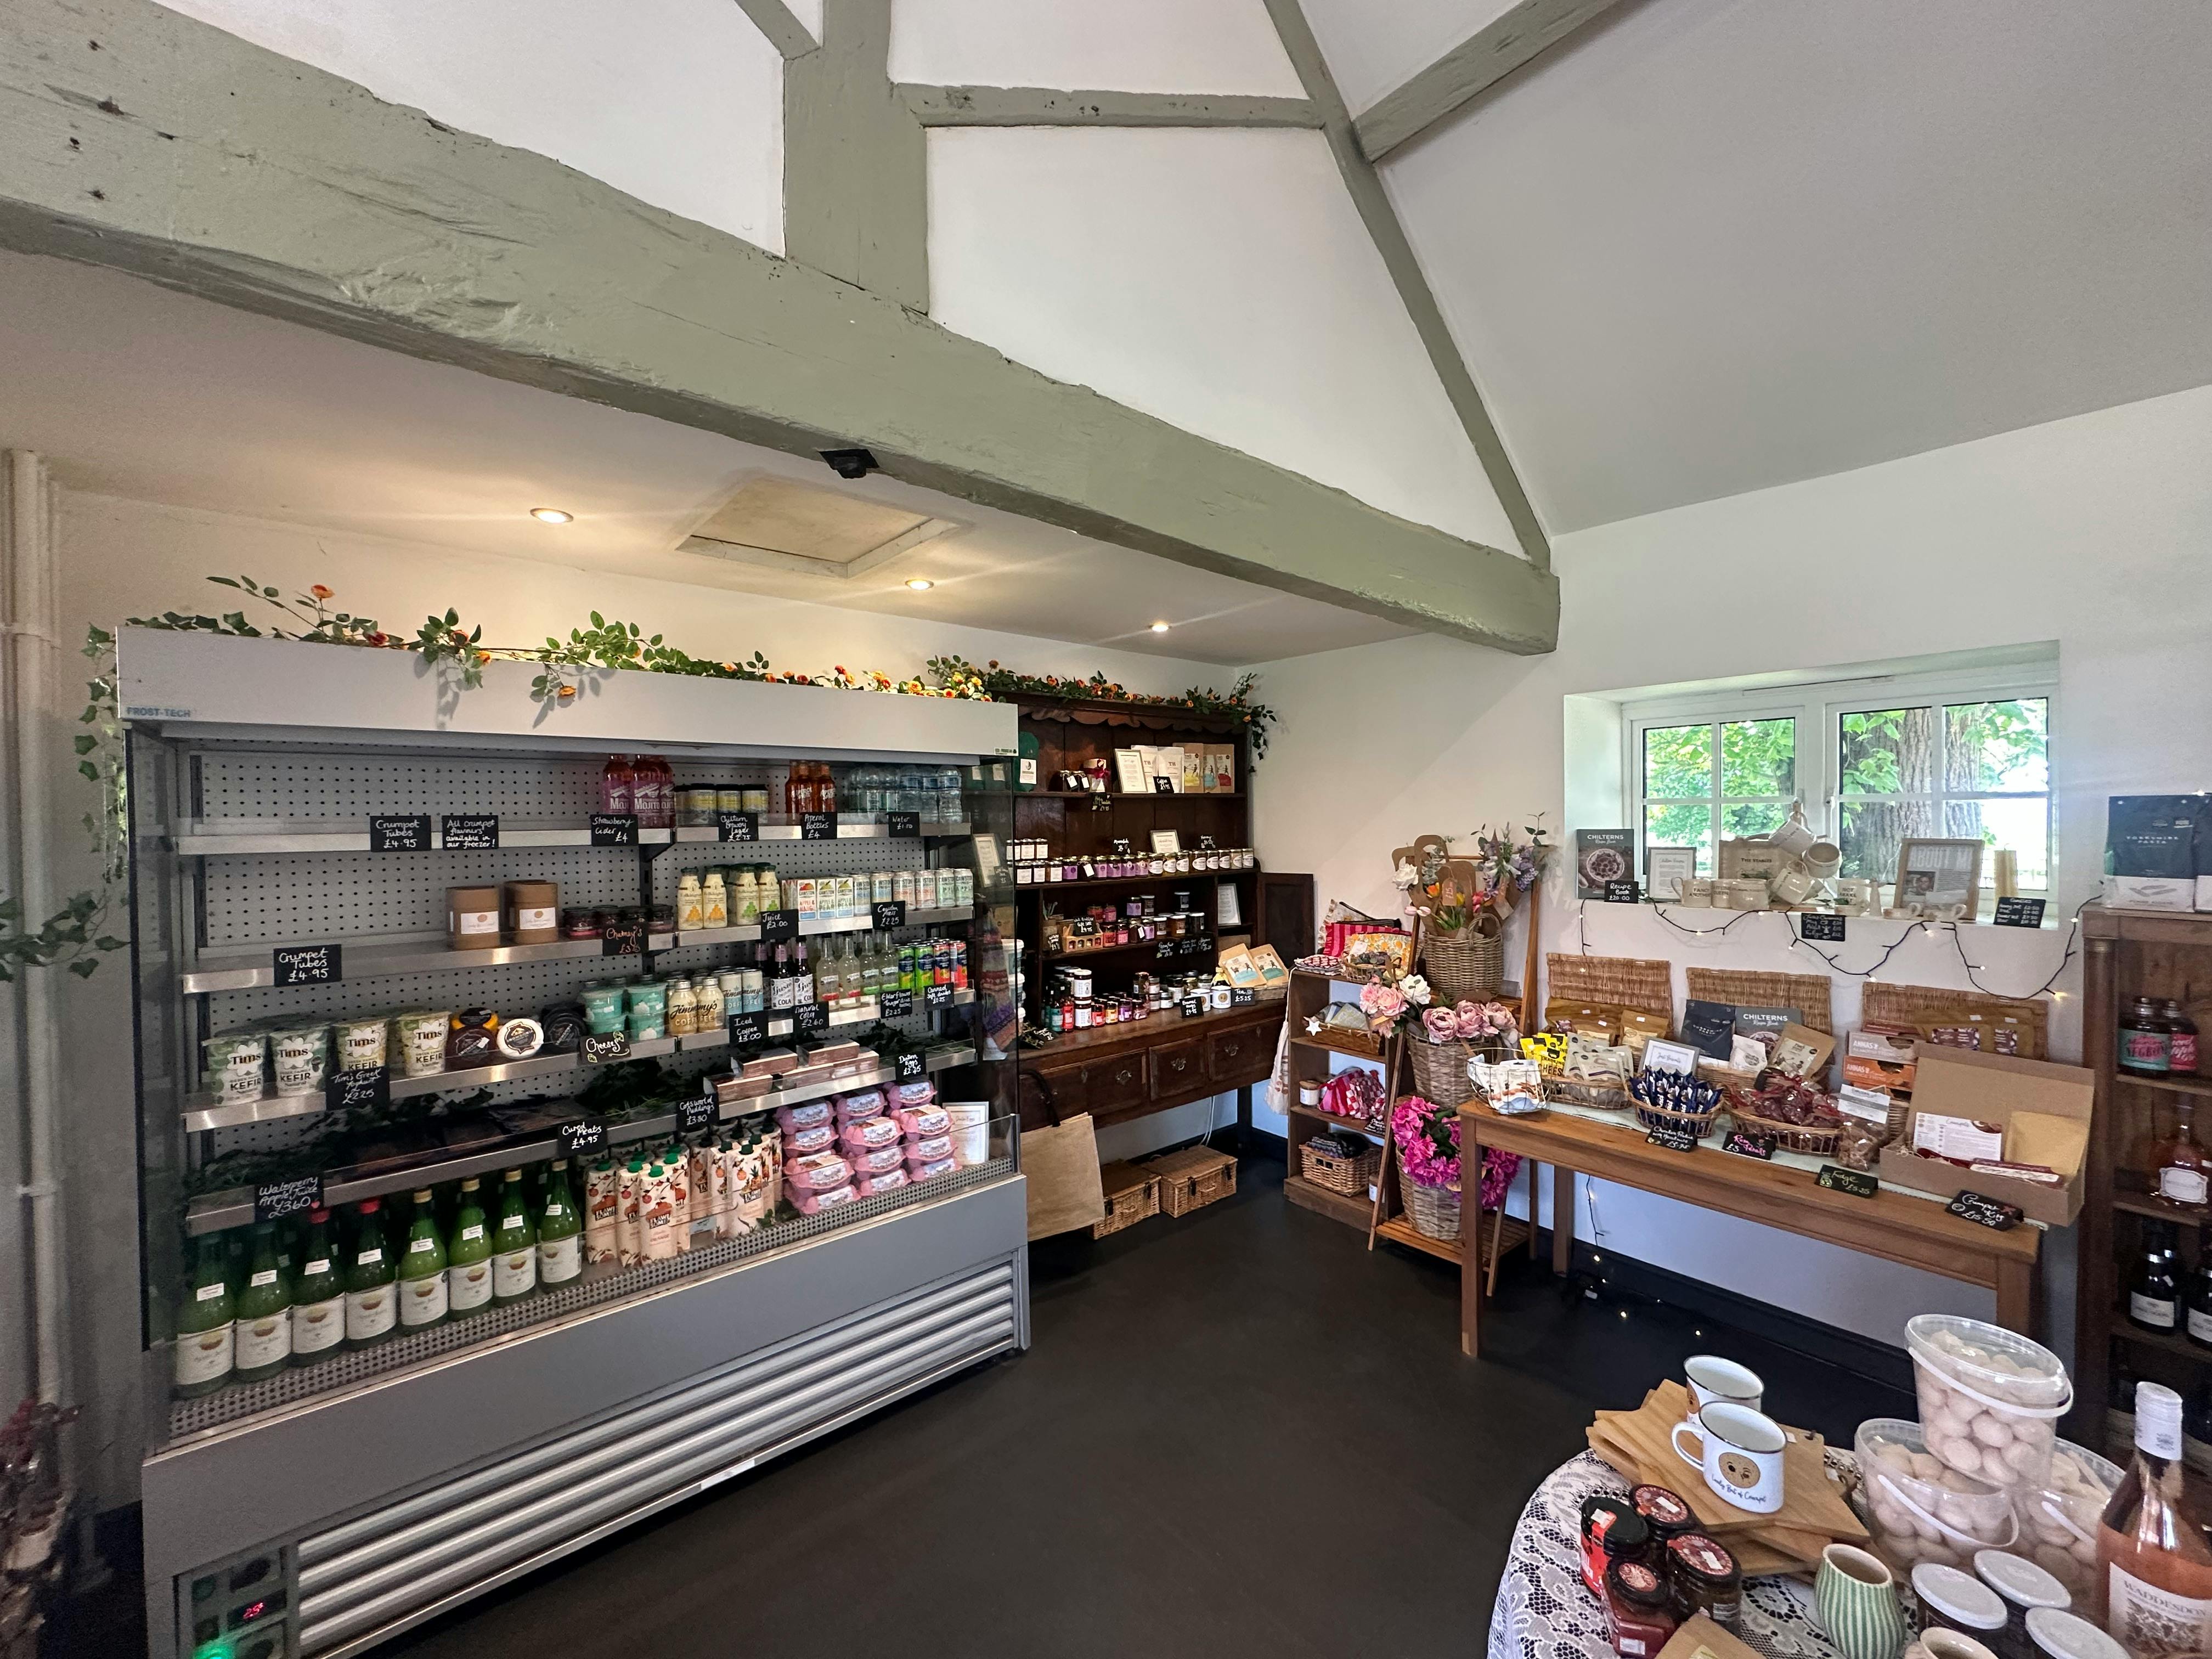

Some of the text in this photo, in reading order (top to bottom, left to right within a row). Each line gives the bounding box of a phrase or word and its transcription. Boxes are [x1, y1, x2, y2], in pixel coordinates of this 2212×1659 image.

[376, 819, 420, 831] Crumpet
[614, 831, 628, 843] £4
[808, 831, 821, 839] £4
[279, 947, 328, 963] Crumpet
[290, 958, 328, 969] Tubes
[734, 1017, 753, 1026] Iced
[1743, 1013, 1788, 1022] CHILTERNS
[416, 1030, 442, 1040] Tims
[347, 1037, 375, 1047] Tims
[279, 1048, 308, 1058] Tims
[416, 1053, 442, 1063] KEFIR
[232, 1054, 261, 1065] Tims
[348, 1060, 377, 1070] KEFIR
[280, 1073, 311, 1082] KEFIR
[230, 1078, 261, 1091] KEFIR
[1832, 1170, 1858, 1185] Fudge
